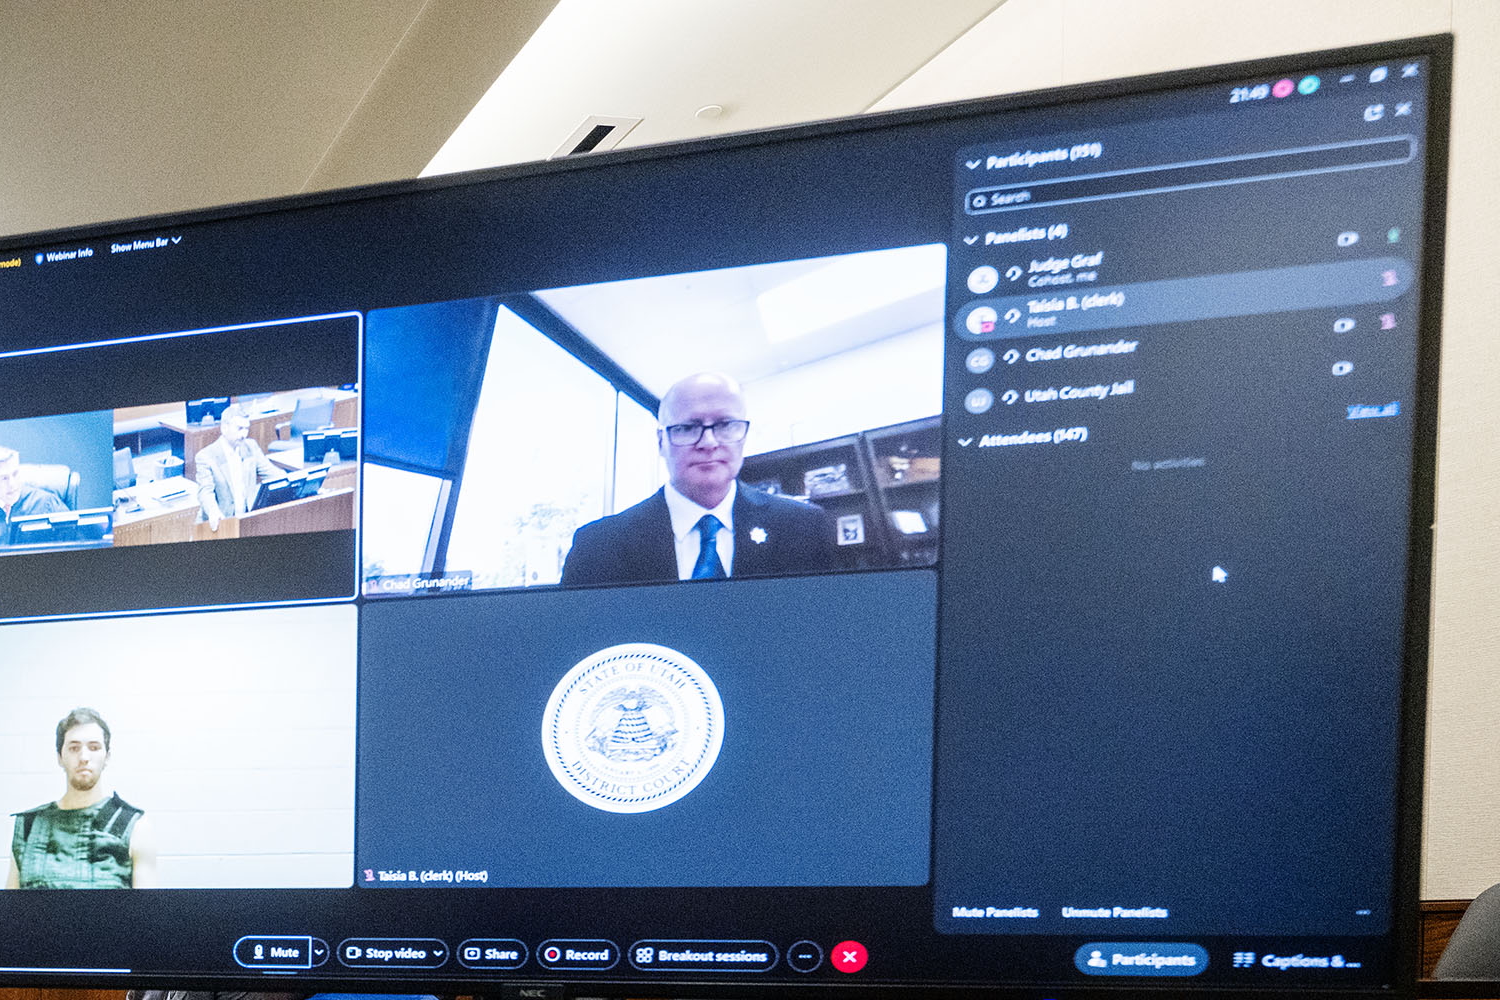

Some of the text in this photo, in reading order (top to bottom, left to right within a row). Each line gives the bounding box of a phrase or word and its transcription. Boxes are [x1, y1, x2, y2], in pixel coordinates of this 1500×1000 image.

[986, 148, 1069, 170] Participants
[991, 190, 1031, 206] Search
[985, 226, 1047, 246] Panelists
[111, 237, 169, 254] Show Menu Bar
[46, 248, 94, 262] Webinar Info
[1028, 251, 1104, 274] Judge Graf
[1025, 338, 1139, 362] Chad Grunander
[1024, 380, 1136, 403] Utah County Jail
[978, 430, 1053, 448] Attendees
[382, 575, 470, 591] Chad Grunander
[579, 662, 686, 695] STATE OF UTAH
[572, 759, 690, 795] DISTRICT COURT
[378, 870, 489, 883] Taisia B. (clerk) (Host)
[952, 906, 1040, 918] Mute Panelists
[1061, 906, 1169, 918] Unmute Panelists
[270, 947, 299, 958] Mute
[366, 947, 426, 961] Stop video
[484, 948, 518, 960] Share
[565, 949, 609, 961] Record
[658, 949, 767, 962] Breakout sessions
[1112, 953, 1197, 969] Participants
[1261, 953, 1329, 971] Captions
[519, 989, 546, 998] NEC
